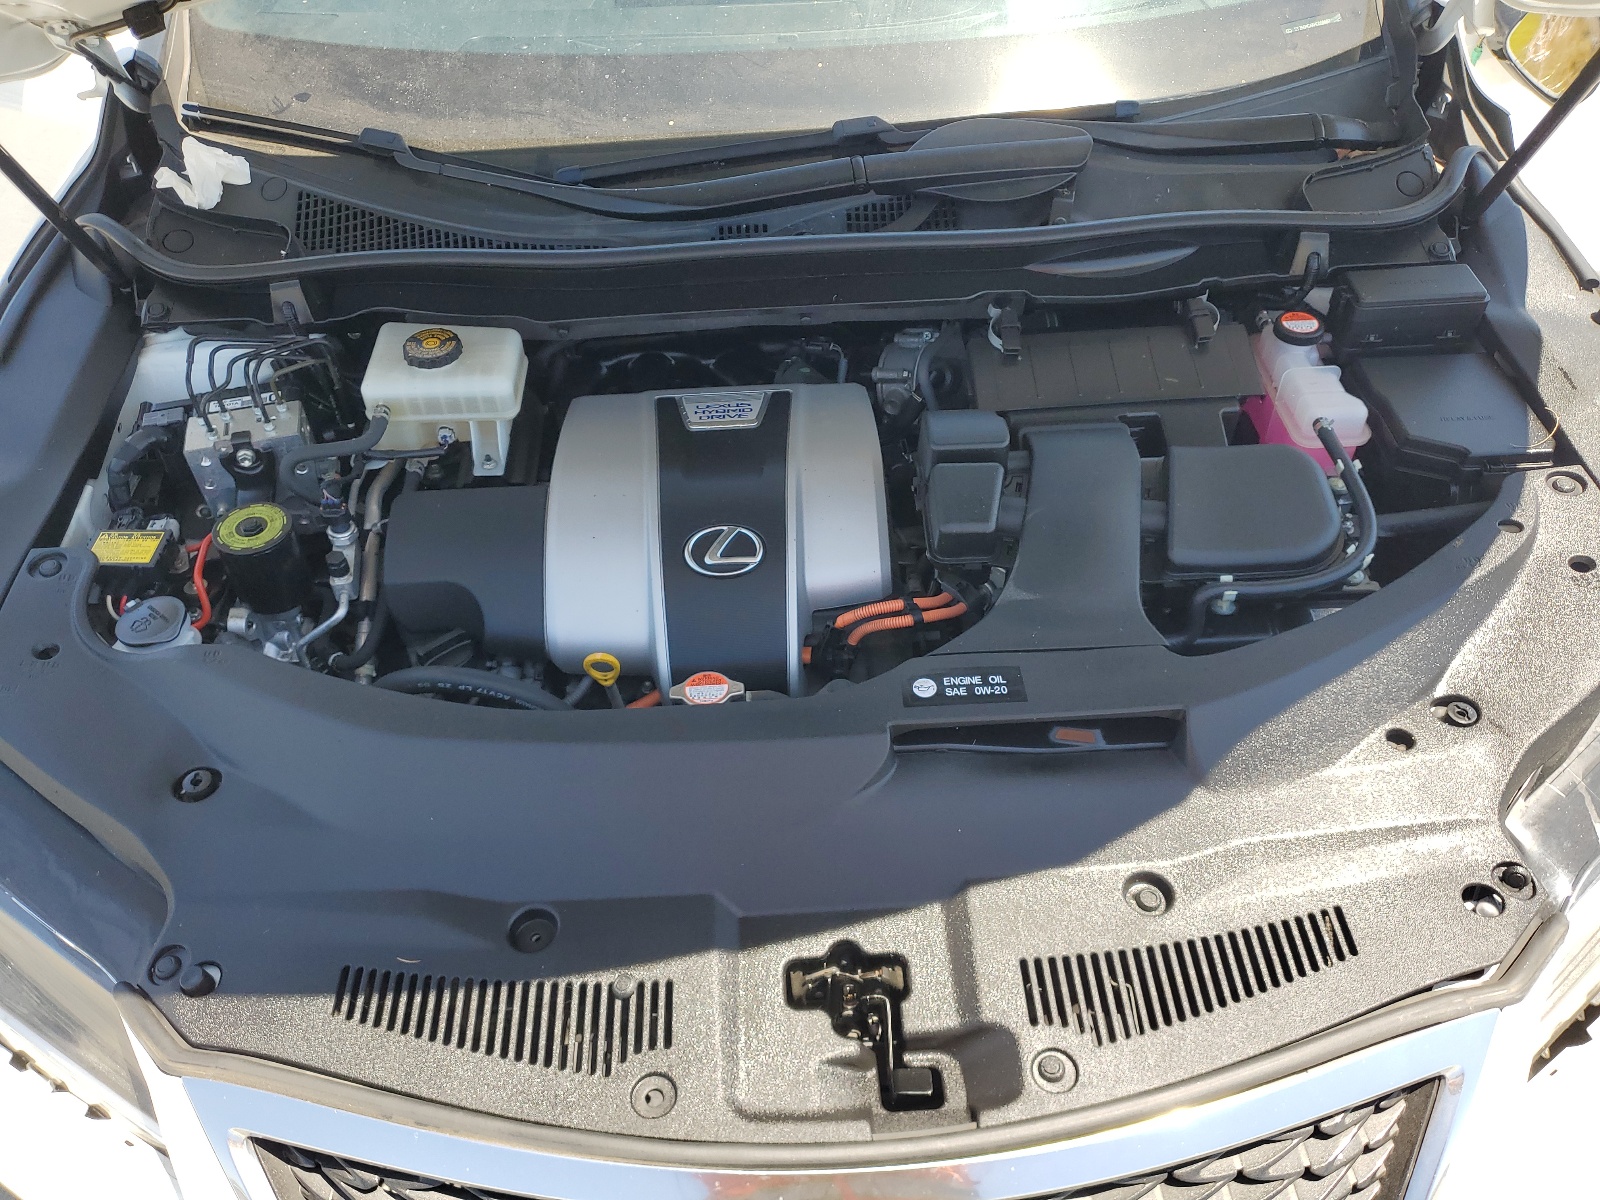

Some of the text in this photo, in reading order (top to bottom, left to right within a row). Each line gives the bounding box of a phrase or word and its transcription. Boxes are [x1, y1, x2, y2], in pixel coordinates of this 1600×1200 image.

[943, 675, 1007, 686] ENGINE OIL
[945, 685, 1008, 697] SAE 0W-20
